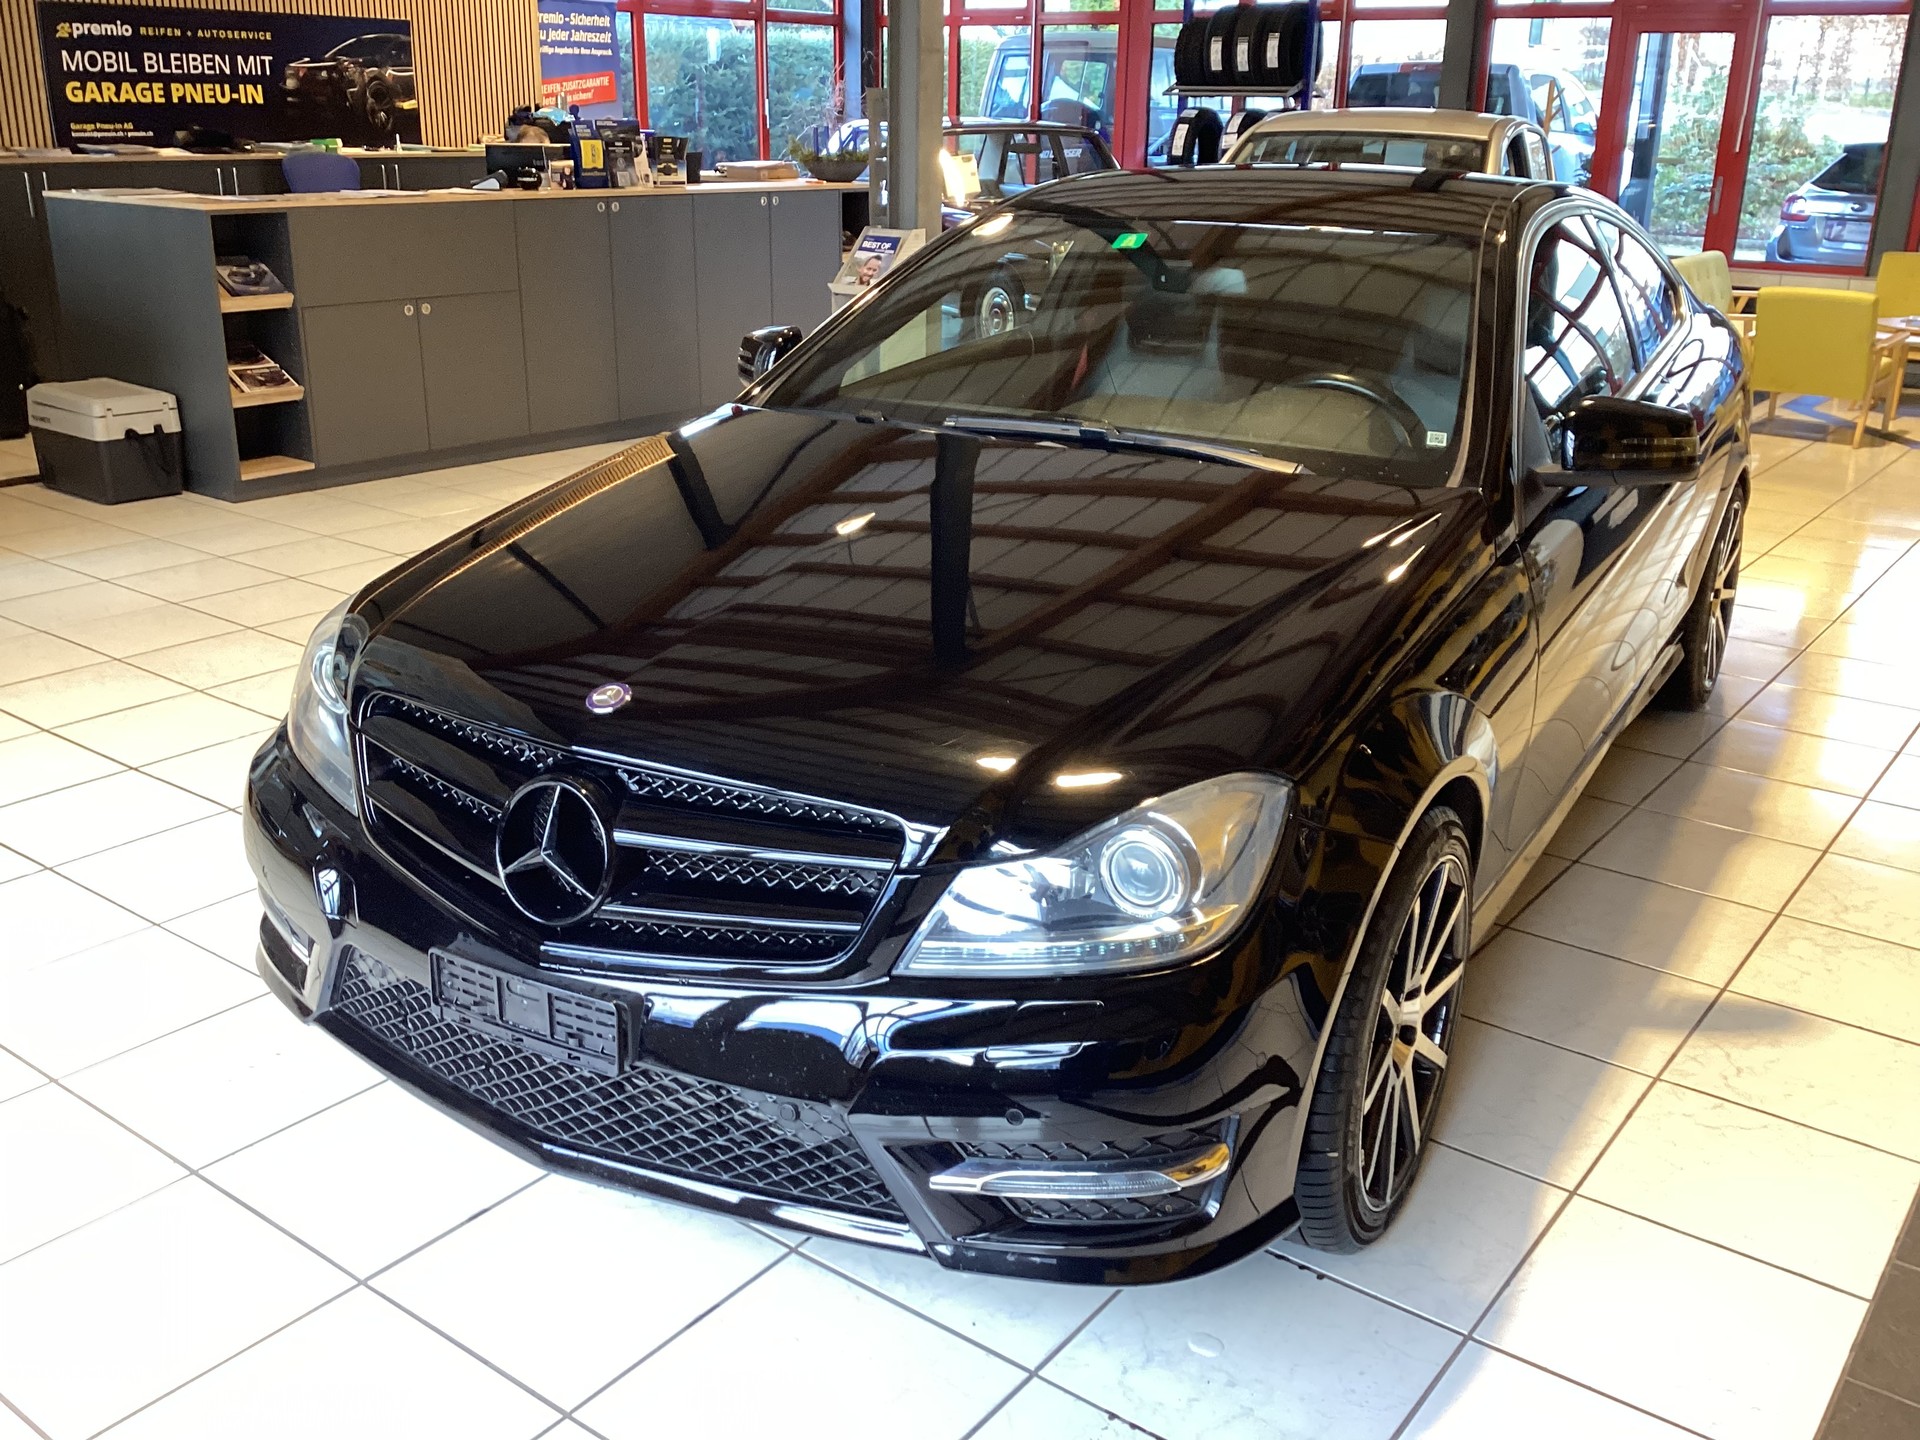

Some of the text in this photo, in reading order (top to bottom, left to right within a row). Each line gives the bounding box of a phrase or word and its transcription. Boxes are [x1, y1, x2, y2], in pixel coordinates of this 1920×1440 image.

[570, 12, 611, 27] Sicherheit
[71, 20, 133, 39] premio
[139, 26, 181, 37] REIFEN
[197, 29, 272, 41] AUTOSERVICE
[547, 28, 569, 42] jeder
[570, 29, 612, 43] Jahreszeit
[61, 49, 273, 76] MOBIL BLEIBEN MIT
[65, 81, 264, 104] GARAGE PNEU-IN
[862, 241, 881, 249] BEST
